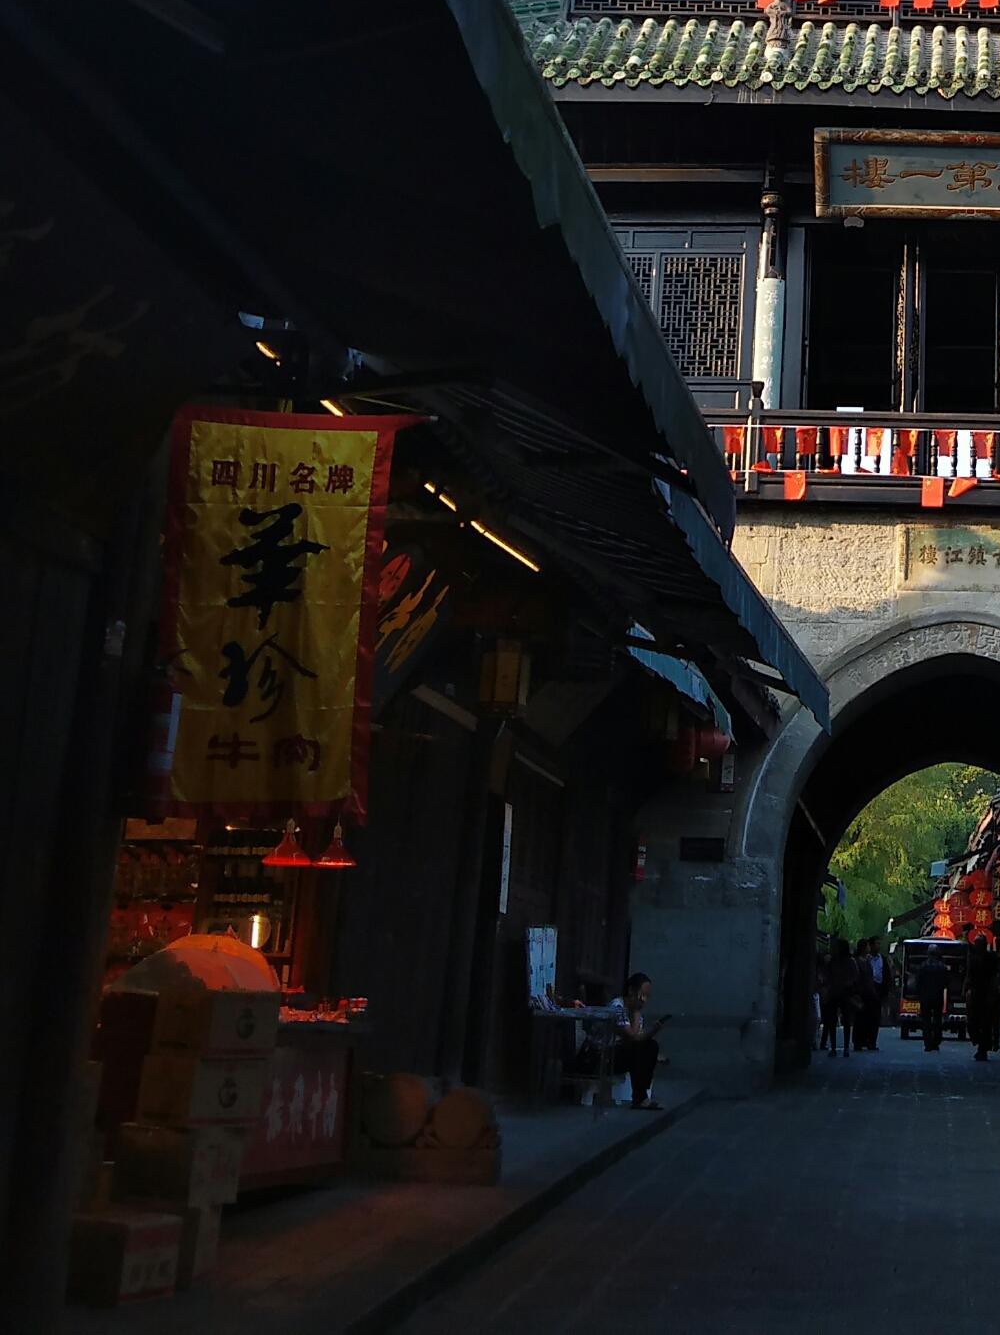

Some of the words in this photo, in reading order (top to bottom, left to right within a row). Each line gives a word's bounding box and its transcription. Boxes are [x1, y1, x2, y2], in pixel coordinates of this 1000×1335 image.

[211, 460, 356, 495] 四川名牌
[206, 732, 322, 771] 牛肉
